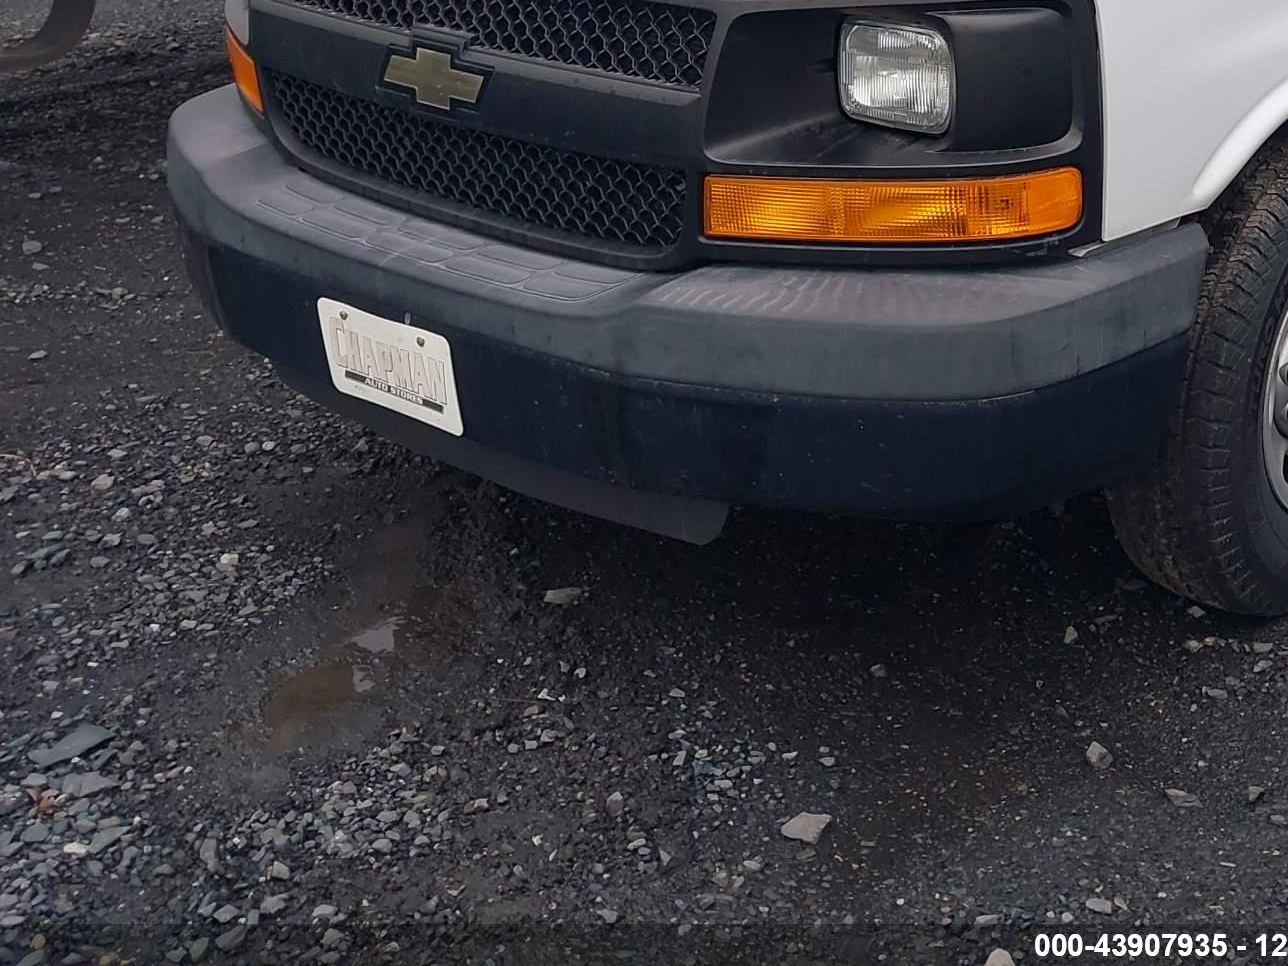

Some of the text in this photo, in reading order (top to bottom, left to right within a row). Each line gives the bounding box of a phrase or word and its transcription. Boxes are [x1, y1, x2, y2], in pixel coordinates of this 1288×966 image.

[328, 316, 448, 405] CHAPMAN
[364, 377, 425, 405] AUTO STORES
